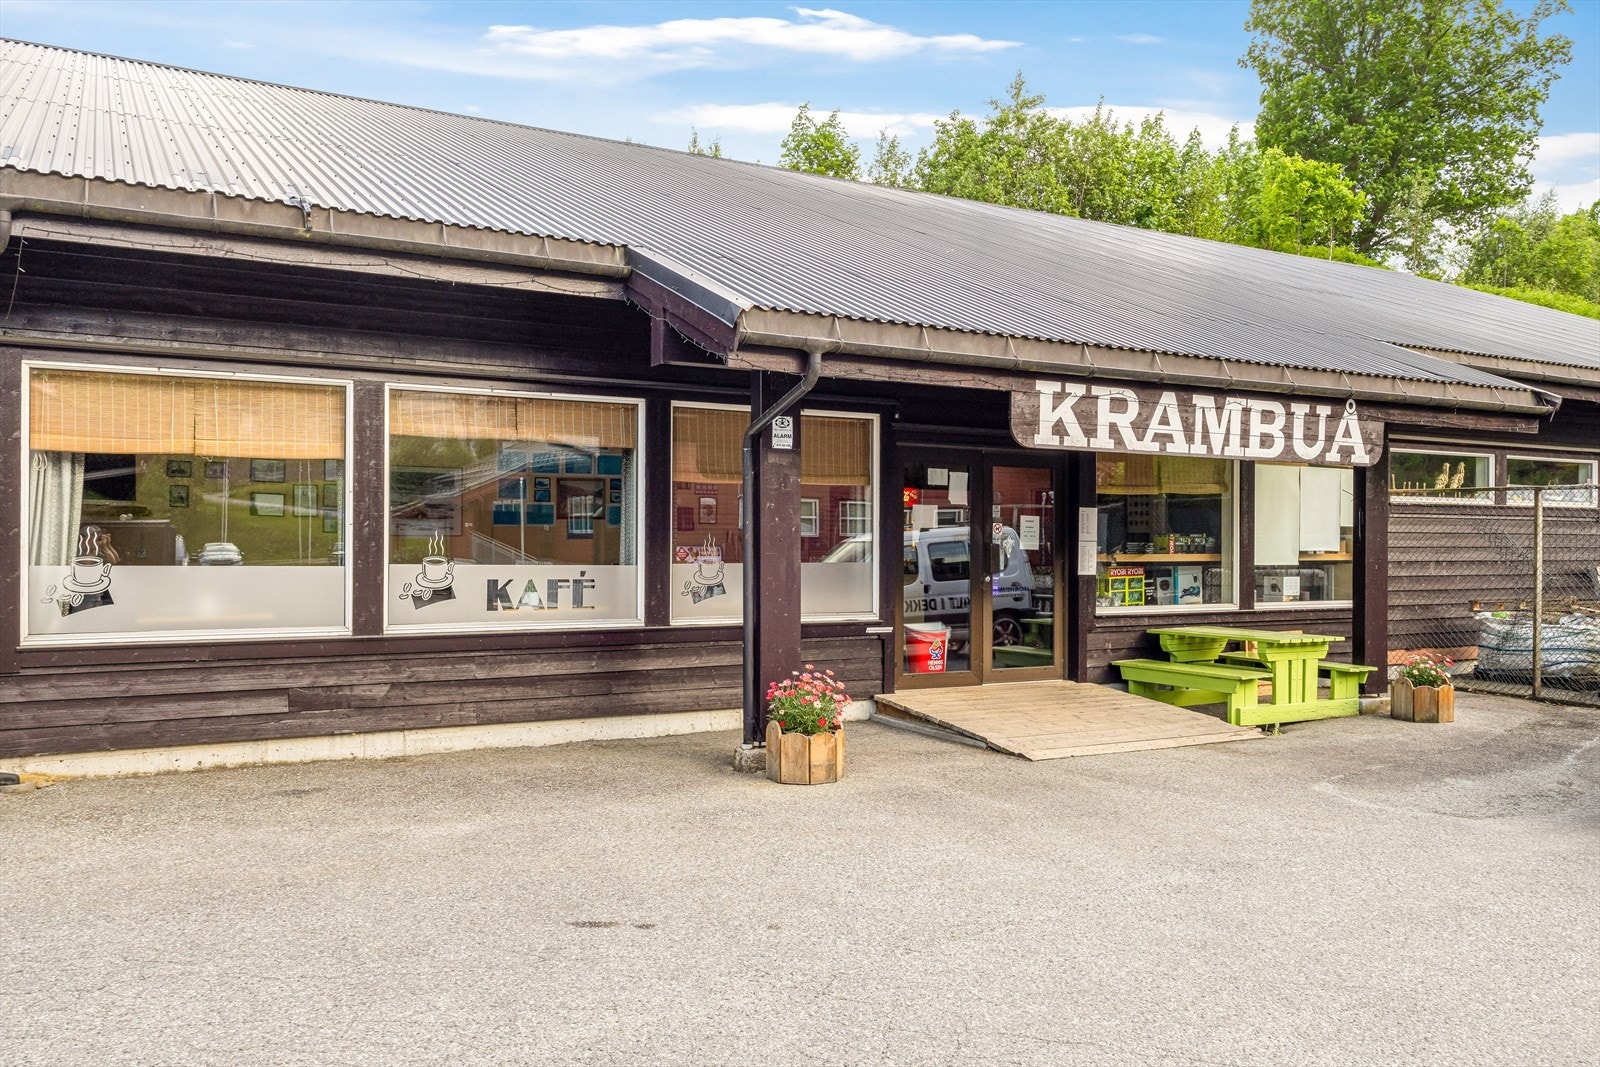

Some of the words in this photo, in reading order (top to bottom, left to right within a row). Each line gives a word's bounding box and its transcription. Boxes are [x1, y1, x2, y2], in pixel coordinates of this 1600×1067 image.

[1034, 379, 1370, 464] KRAMBUÅ
[486, 570, 595, 611] KAFÉ
[1110, 568, 1127, 576] RYOBI
[1127, 567, 1144, 575] RYOBI
